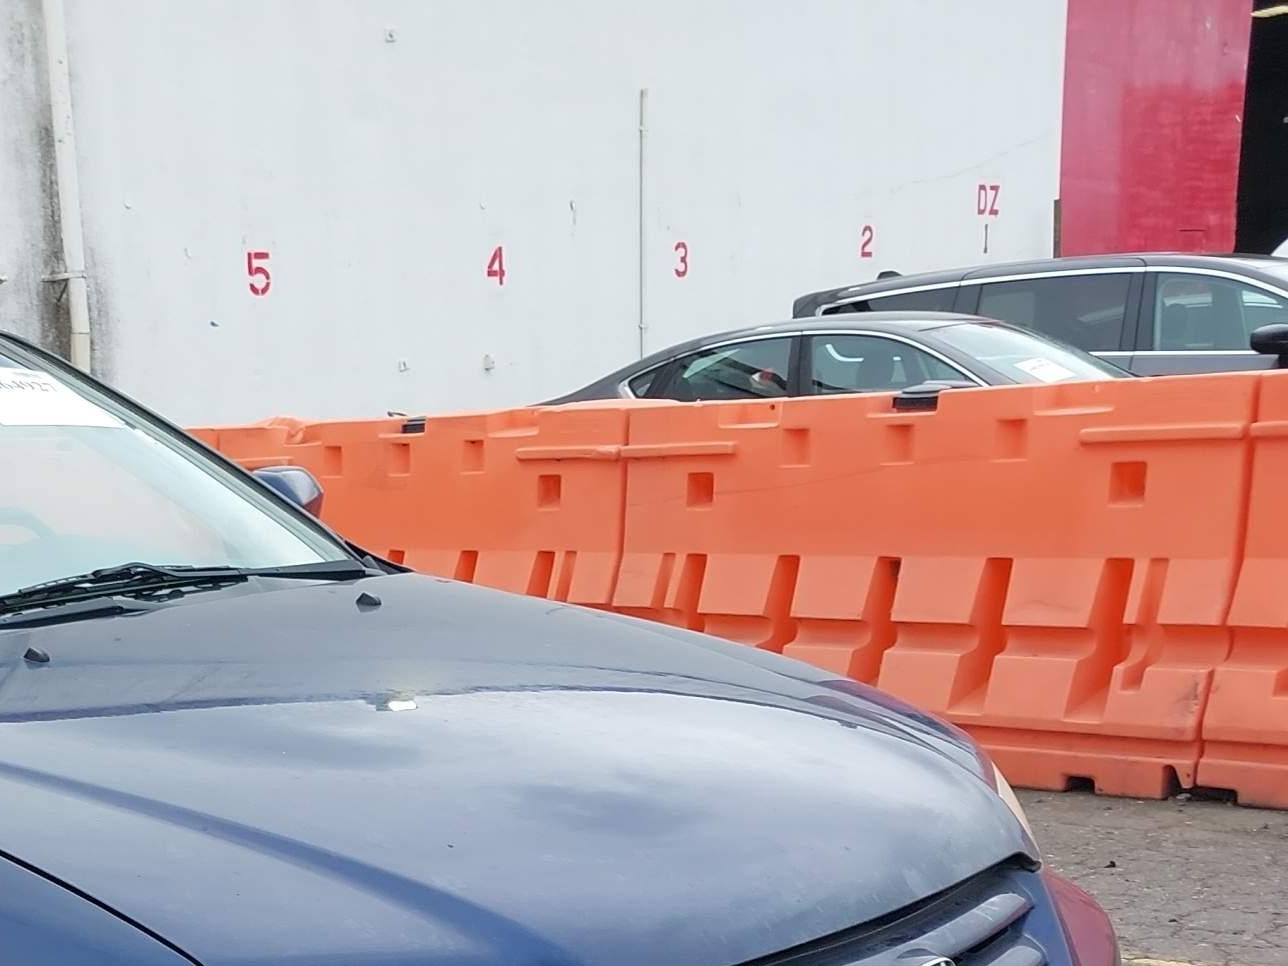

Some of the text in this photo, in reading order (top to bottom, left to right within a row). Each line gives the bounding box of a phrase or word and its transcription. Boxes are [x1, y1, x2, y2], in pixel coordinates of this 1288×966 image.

[976, 184, 1001, 217] DZ
[674, 241, 689, 279] 3
[859, 225, 874, 259] 2
[246, 251, 272, 297] 5
[487, 246, 506, 286] 4
